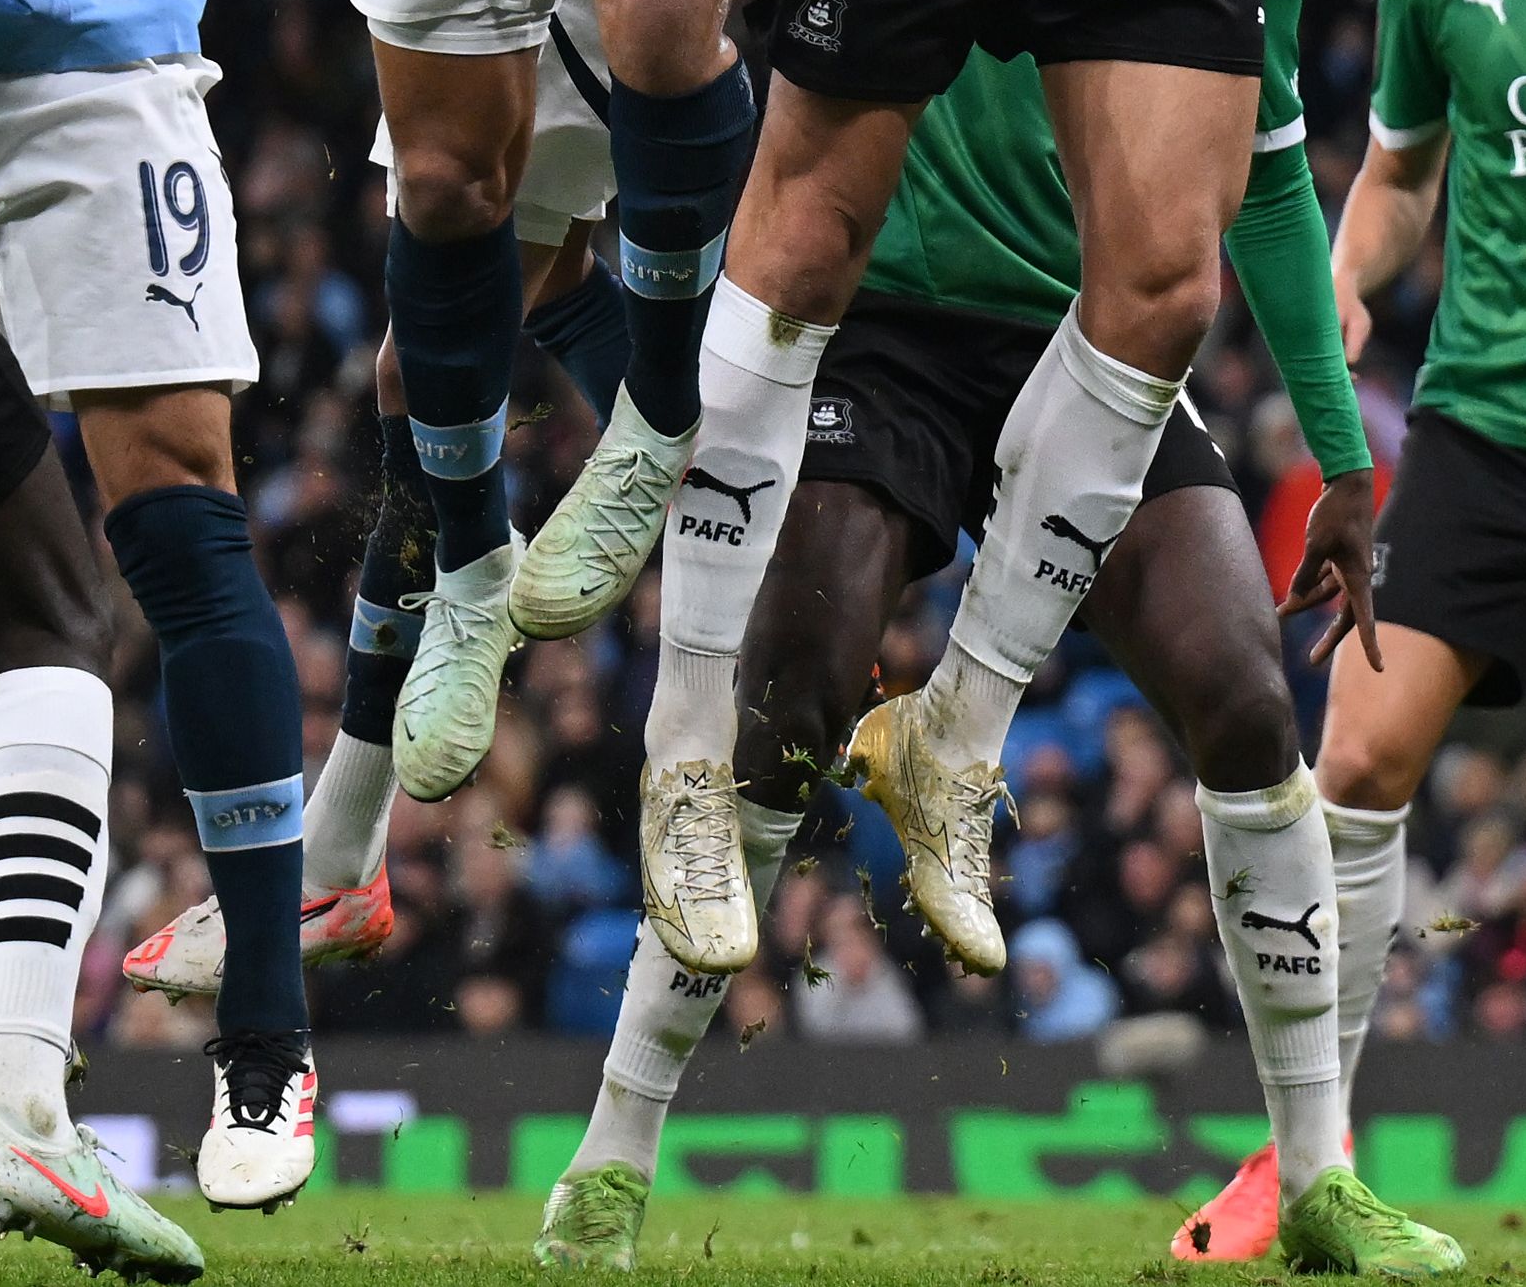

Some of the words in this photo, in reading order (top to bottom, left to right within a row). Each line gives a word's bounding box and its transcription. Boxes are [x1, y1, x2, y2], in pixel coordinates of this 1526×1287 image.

[139, 159, 210, 277] 19
[678, 514, 745, 547] PAFC
[1034, 559, 1092, 595] PAFC
[1257, 952, 1321, 976] PAFC
[669, 970, 727, 998] PAFC
